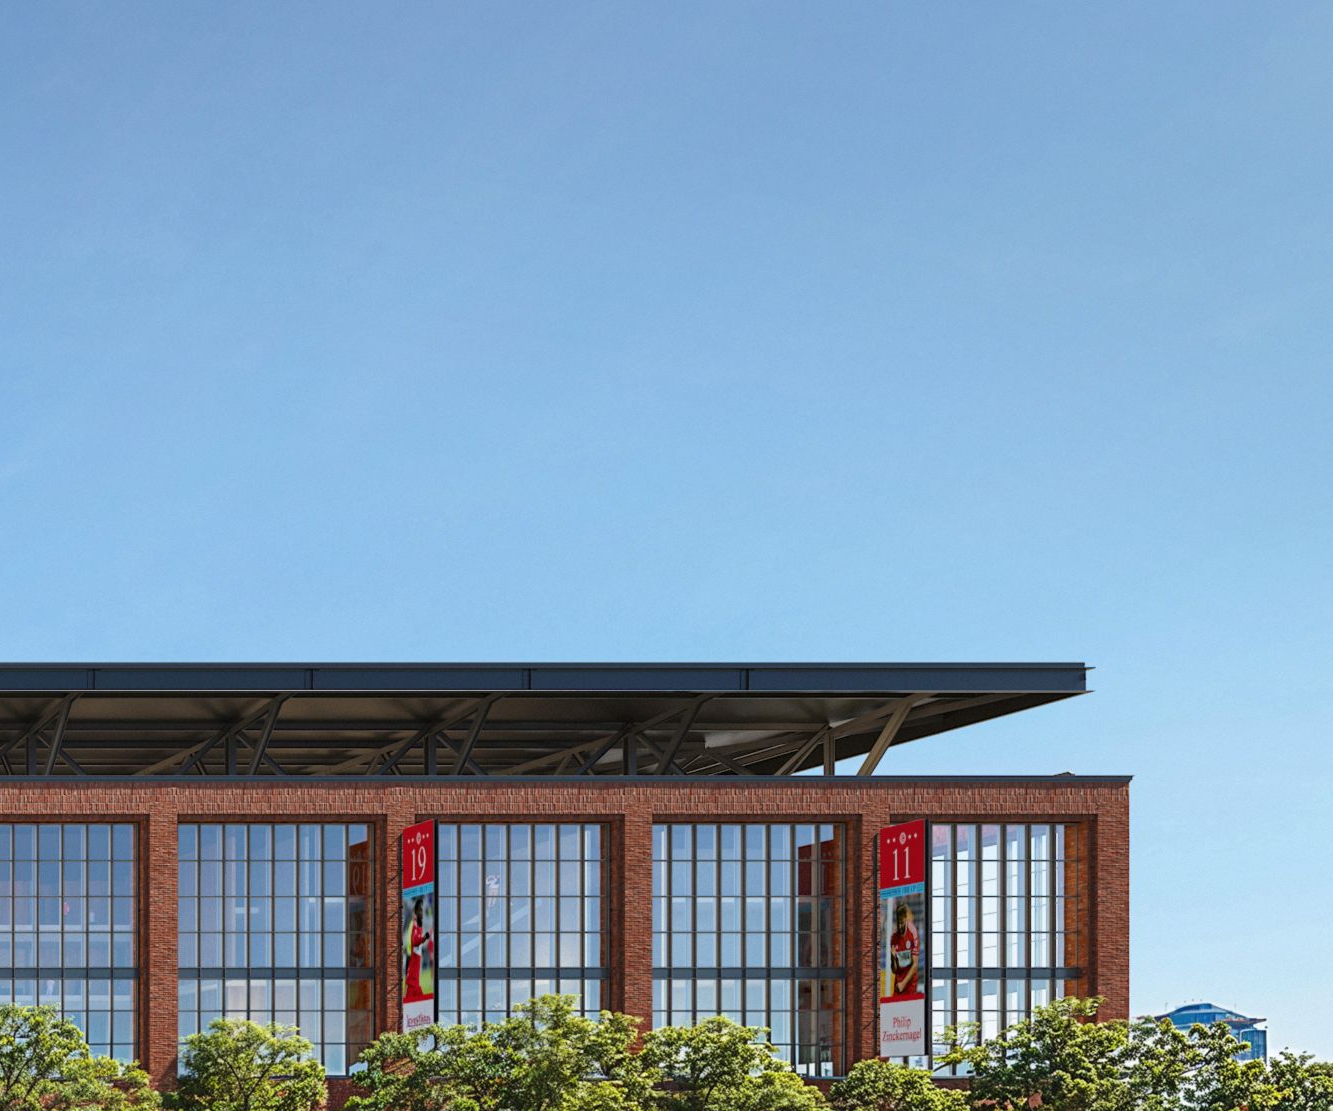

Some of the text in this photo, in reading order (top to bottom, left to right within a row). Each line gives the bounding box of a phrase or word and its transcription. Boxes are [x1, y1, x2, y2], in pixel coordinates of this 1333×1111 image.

[411, 846, 427, 881] 19
[893, 846, 911, 881] 11
[893, 1016, 912, 1029] Philip
